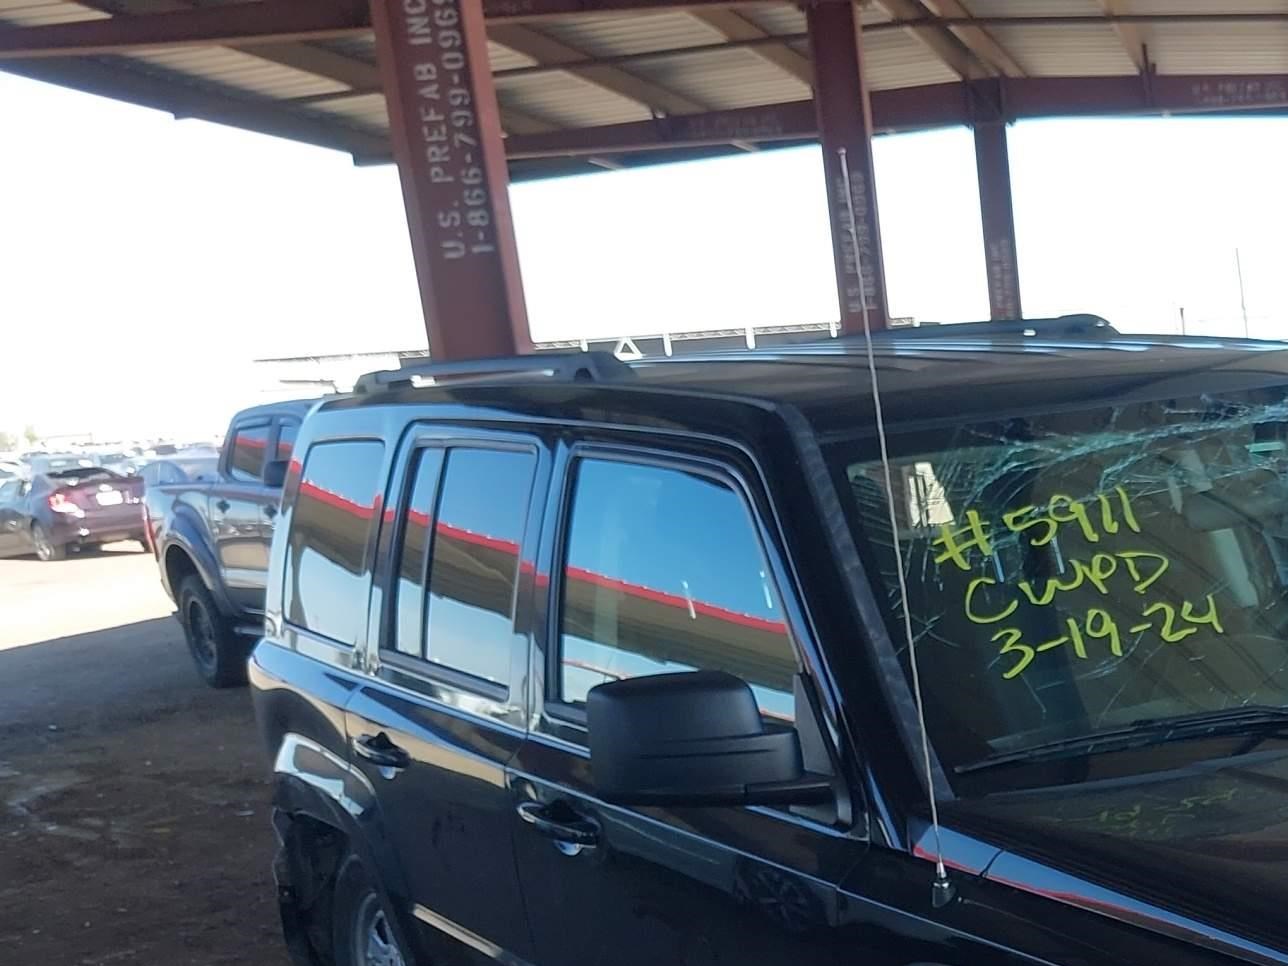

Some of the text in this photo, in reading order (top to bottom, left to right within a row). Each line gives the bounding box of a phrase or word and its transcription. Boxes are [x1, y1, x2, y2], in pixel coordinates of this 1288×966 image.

[403, 0, 467, 259] U.S. PREFAB INC
[434, 0, 495, 254] 1-866-799-096
[933, 486, 1141, 571] #5911
[991, 593, 1224, 680] 3-19-24
